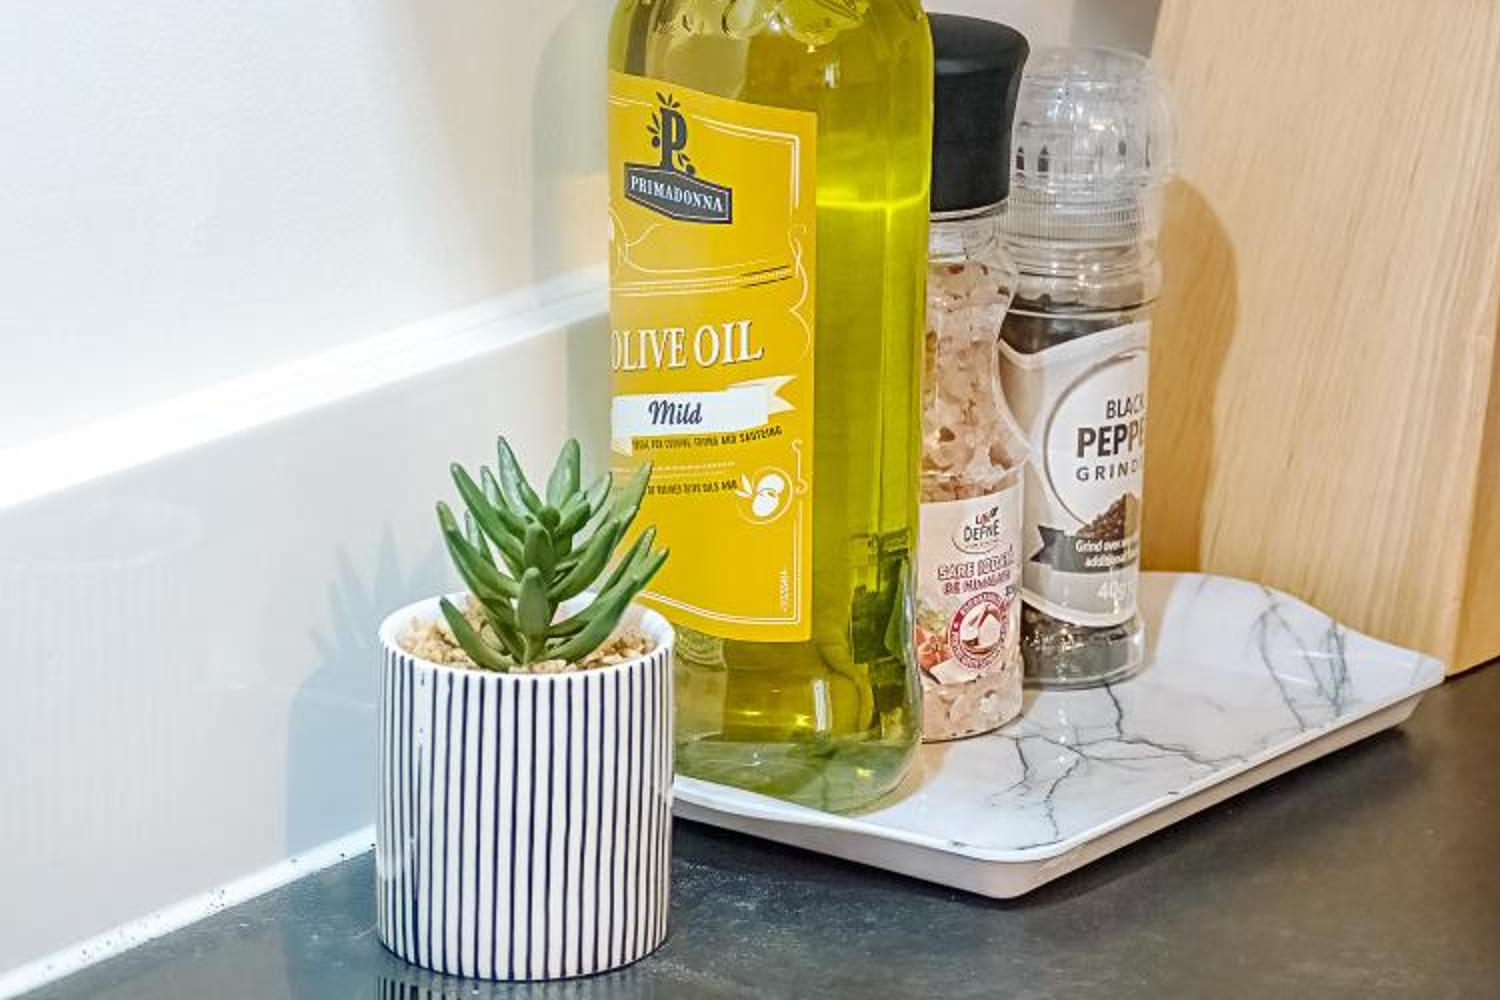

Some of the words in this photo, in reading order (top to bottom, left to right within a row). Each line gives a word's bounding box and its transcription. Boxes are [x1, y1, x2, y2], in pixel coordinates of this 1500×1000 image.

[630, 174, 724, 213] PRIMADONNA
[693, 319, 765, 368] OIL
[648, 399, 703, 425] Mild
